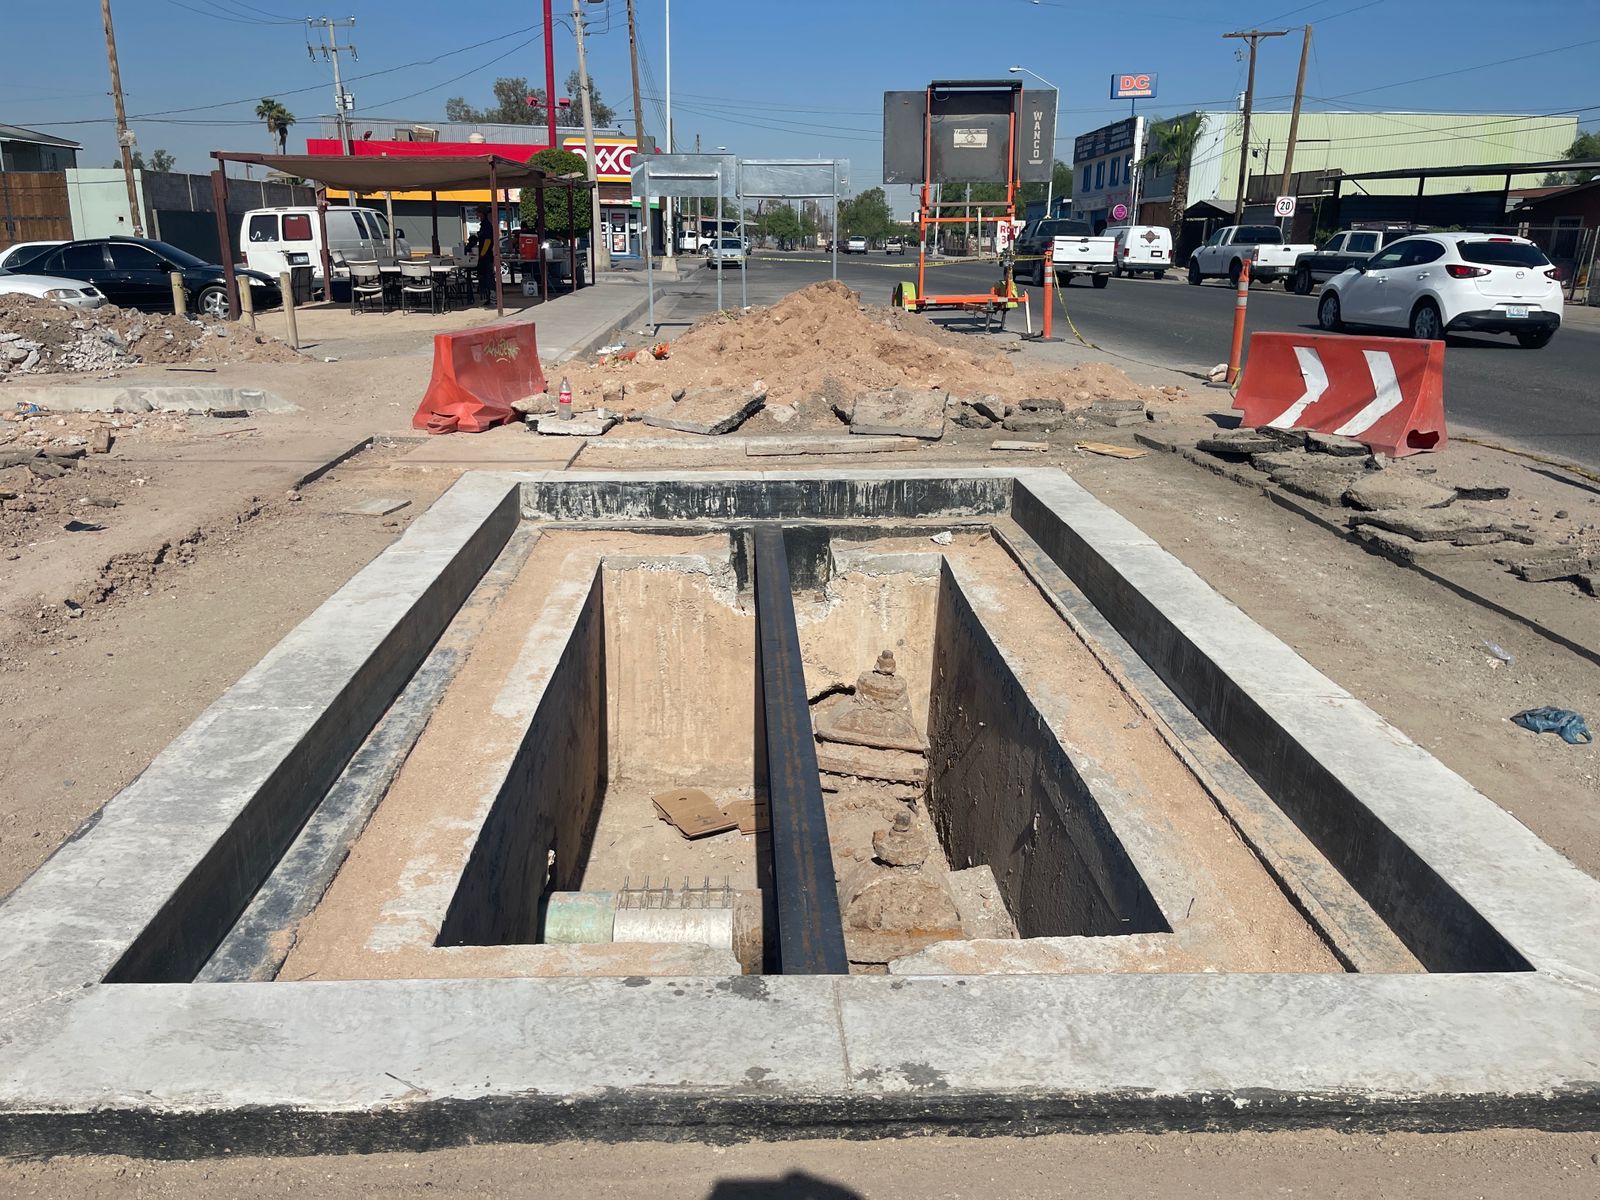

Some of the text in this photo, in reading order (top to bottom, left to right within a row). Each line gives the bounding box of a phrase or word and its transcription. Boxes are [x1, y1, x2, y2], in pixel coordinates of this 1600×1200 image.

[1120, 75, 1150, 90] DC
[1033, 111, 1043, 158] WANCO
[1280, 201, 1291, 210] 20
